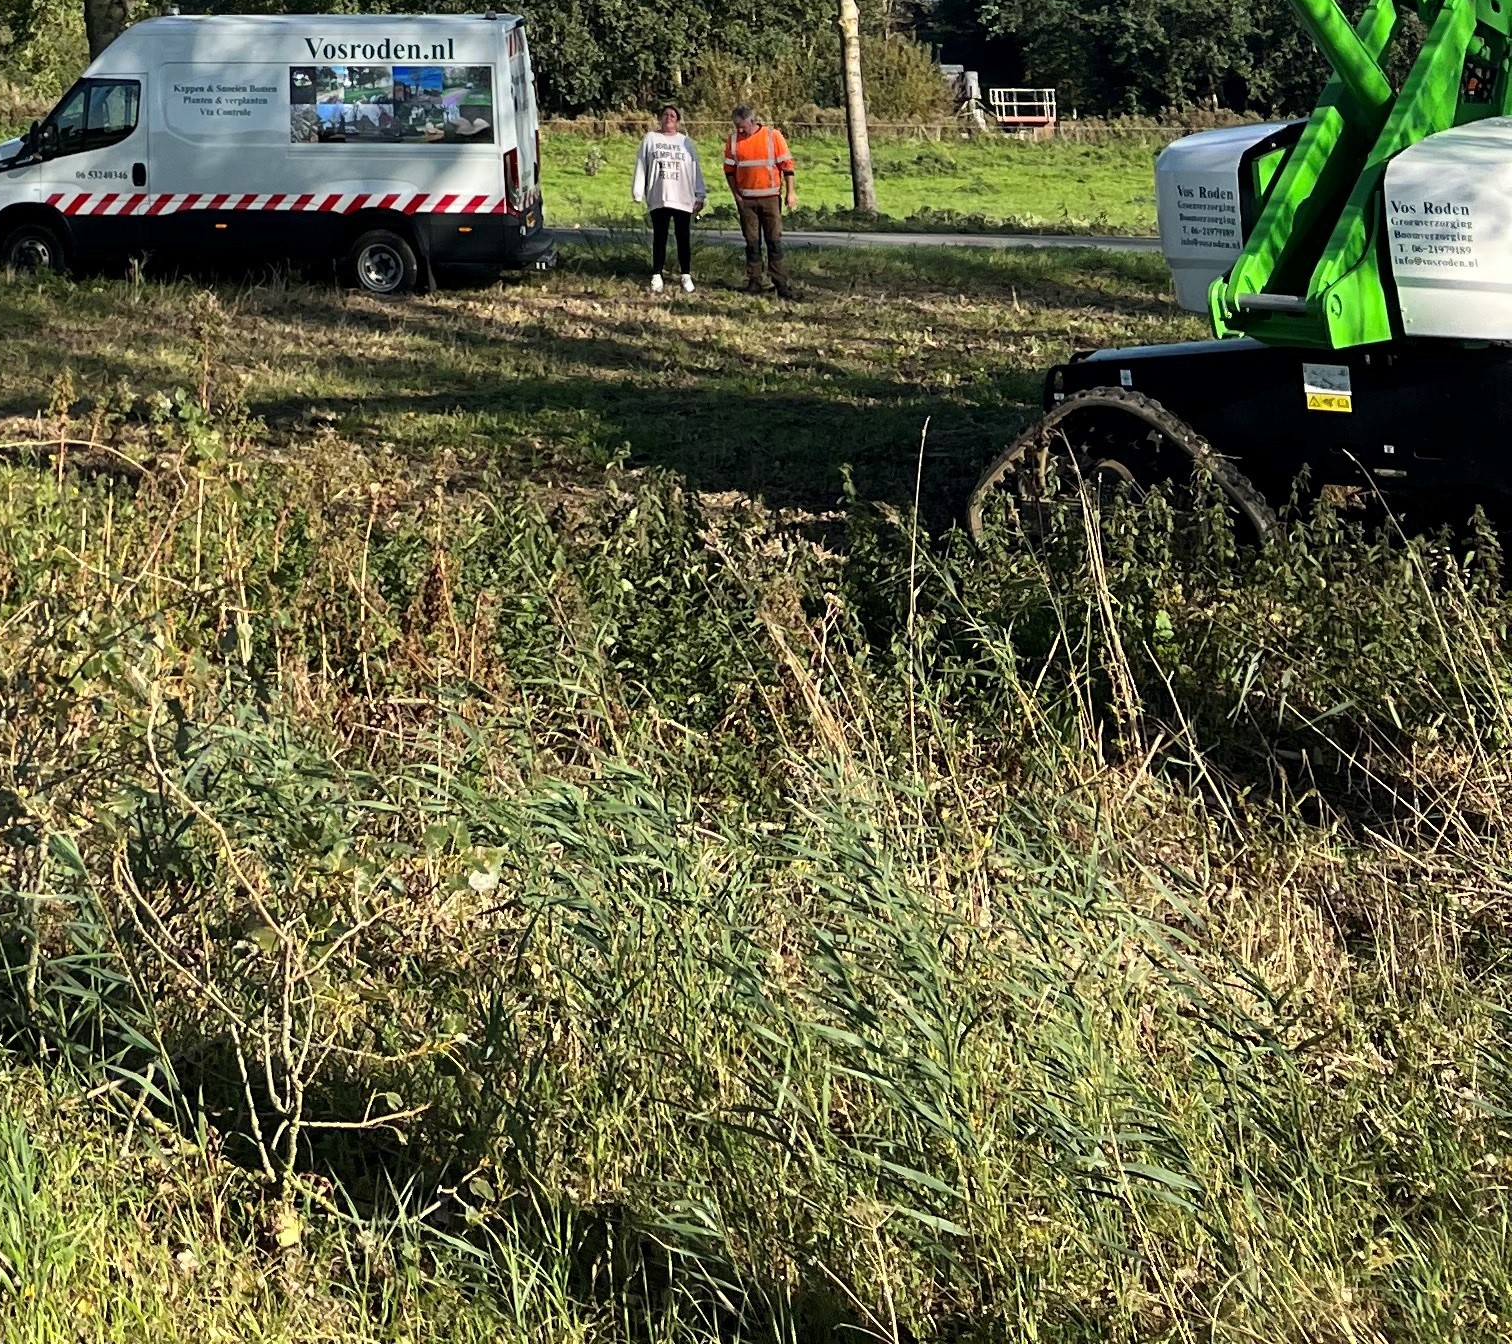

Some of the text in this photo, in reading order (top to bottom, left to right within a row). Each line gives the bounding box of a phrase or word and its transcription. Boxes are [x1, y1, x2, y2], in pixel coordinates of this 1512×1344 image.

[303, 37, 456, 60] Vosroden.nl
[183, 96, 213, 104] Planten
[225, 96, 268, 106] verplanten
[1177, 185, 1234, 200] Vos Roden
[1391, 200, 1470, 216] Vos Roden
[1391, 217, 1473, 229] Groenverzorging
[1394, 230, 1474, 242] Boomverzorging
[1394, 255, 1479, 267] info@vosroden.nl
